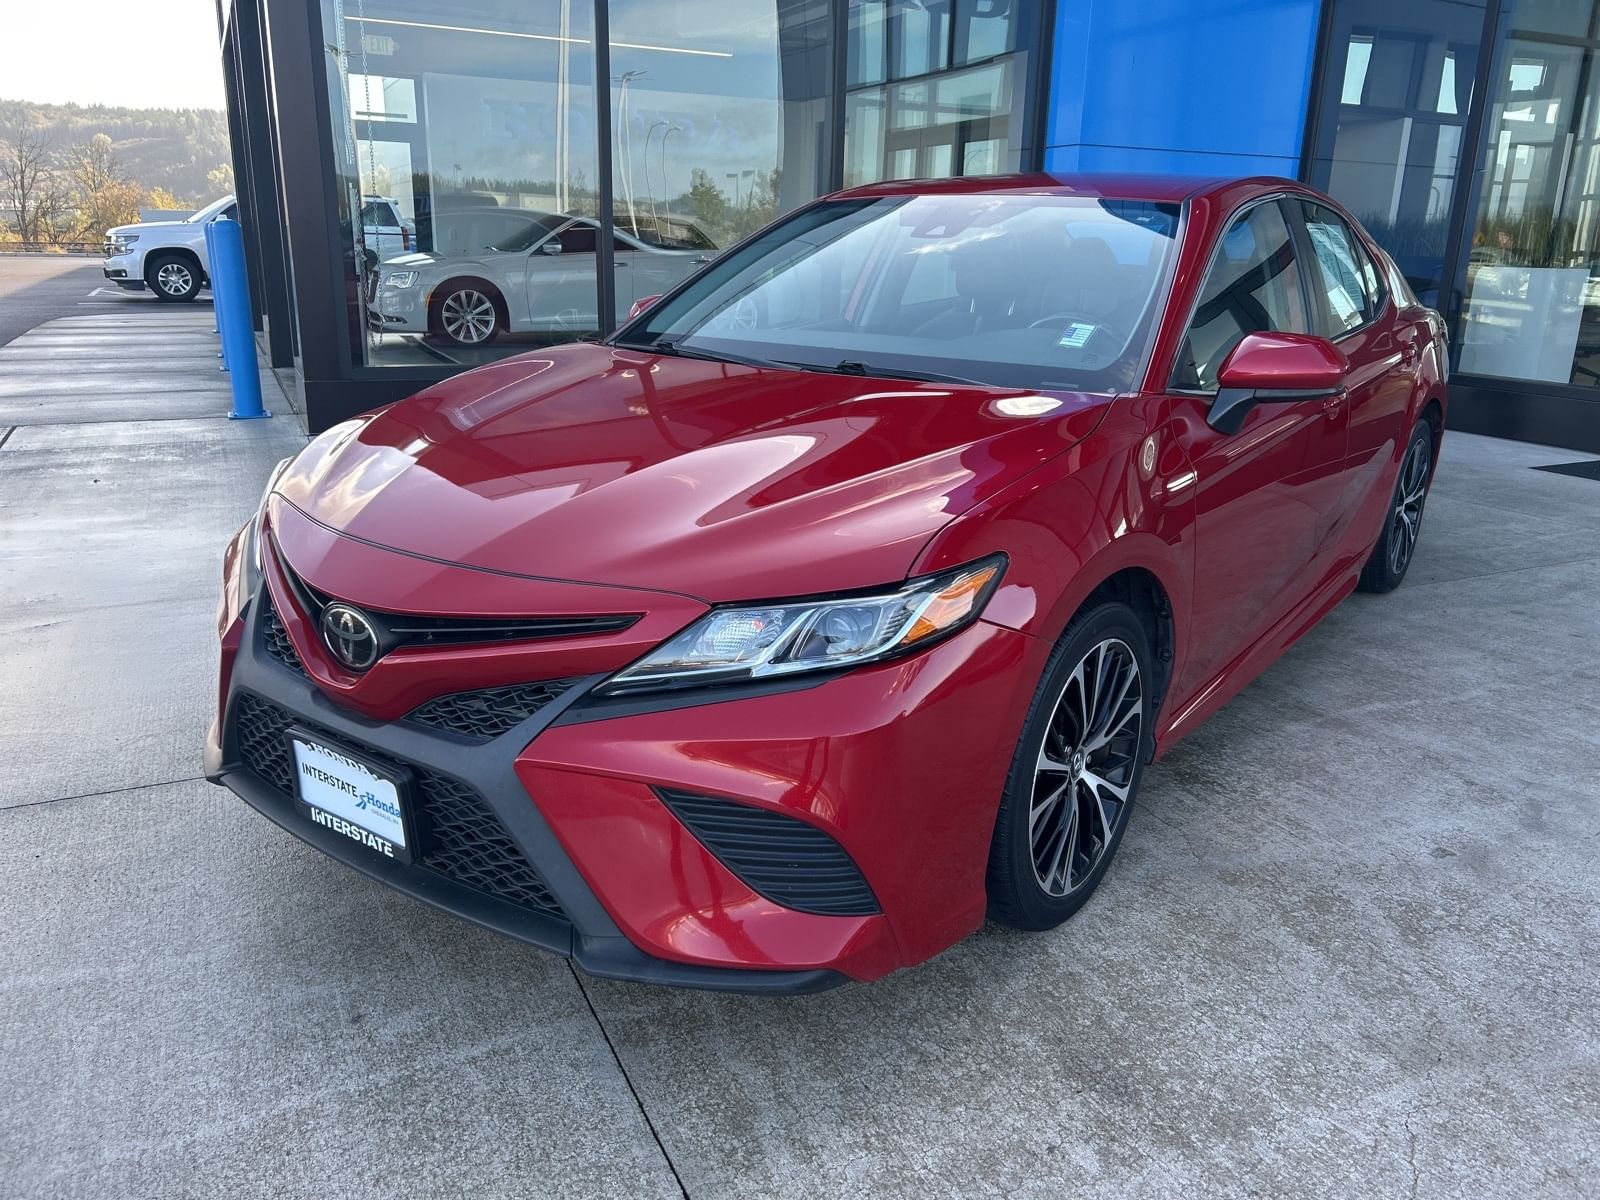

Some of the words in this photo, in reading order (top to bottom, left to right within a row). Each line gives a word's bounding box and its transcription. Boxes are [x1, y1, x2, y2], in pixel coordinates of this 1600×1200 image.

[302, 762, 359, 798] INTERSTATE
[365, 791, 401, 818] Honda
[311, 807, 394, 858] INTERSTATE
